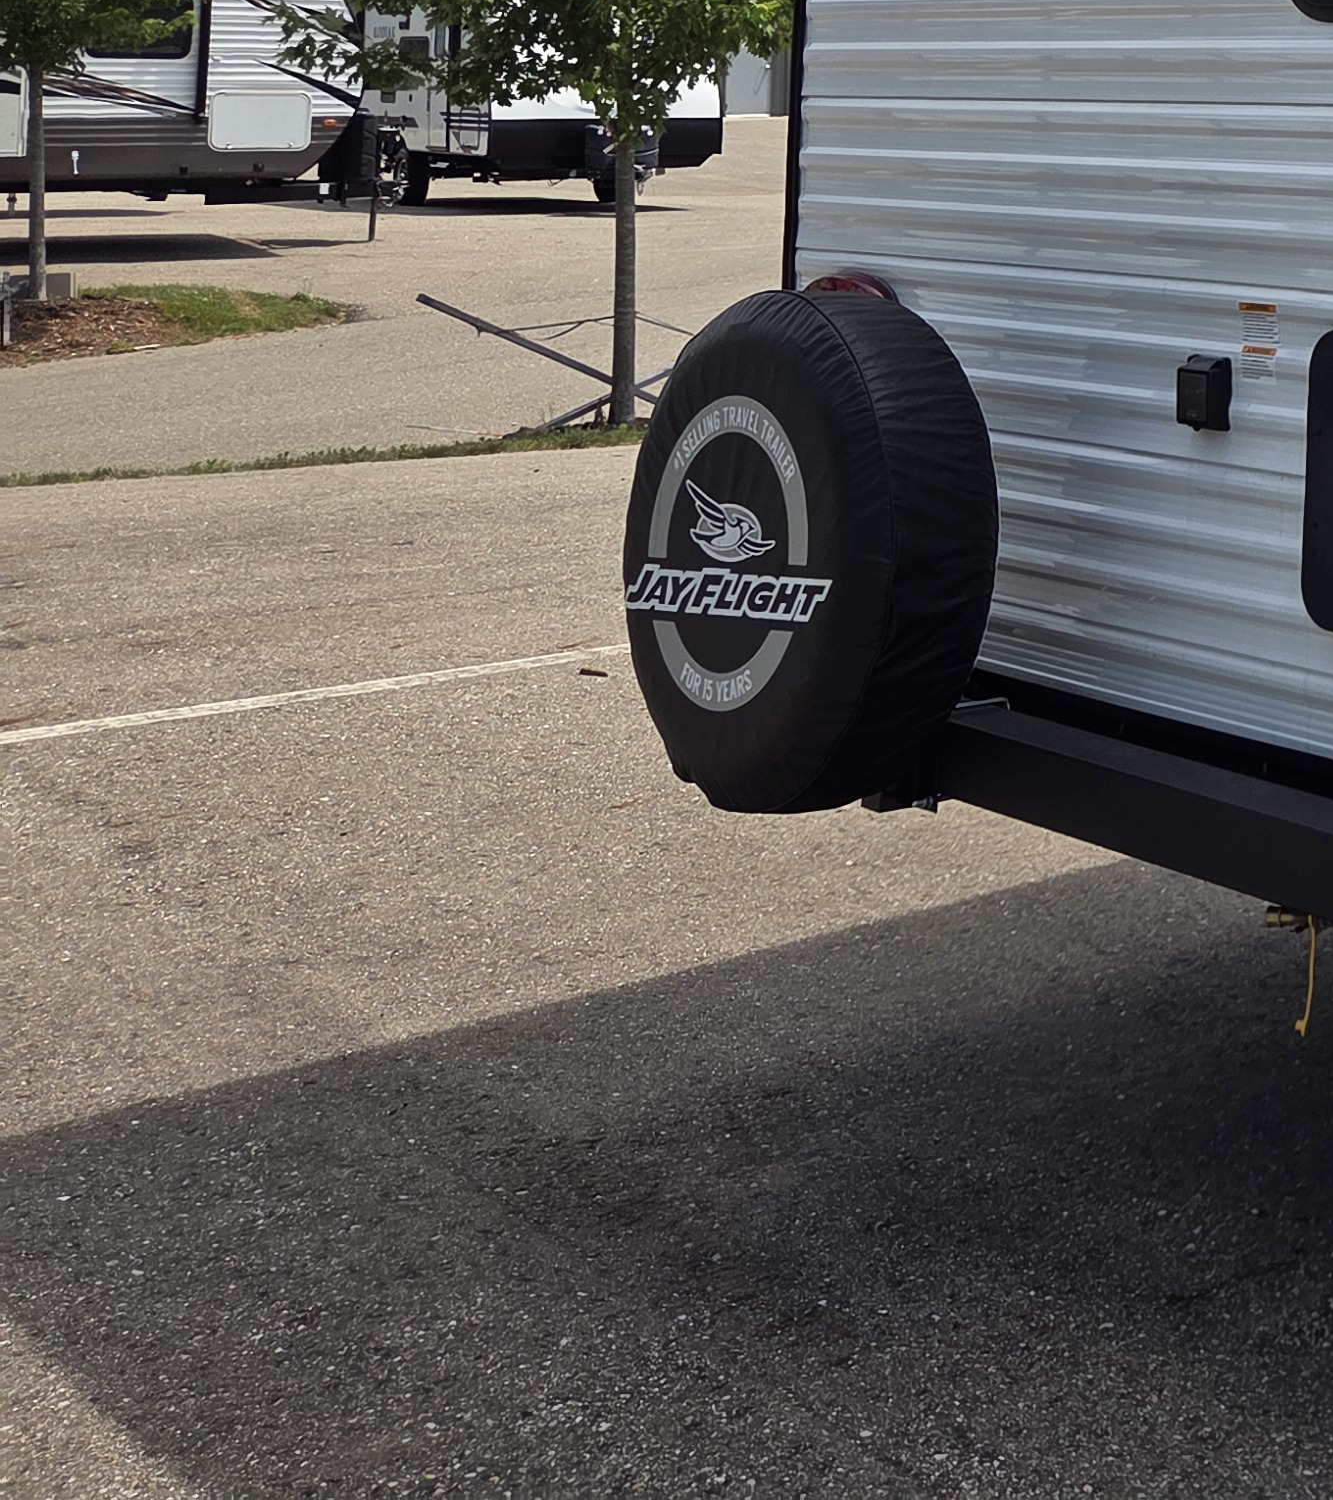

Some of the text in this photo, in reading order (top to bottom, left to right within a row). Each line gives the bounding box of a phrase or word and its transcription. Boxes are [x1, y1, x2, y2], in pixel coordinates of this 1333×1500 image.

[681, 409, 721, 460] SELLING
[722, 405, 760, 435] TRAVEL
[760, 418, 796, 485] TRAILER
[680, 661, 753, 703] FOR 15 YEARS
